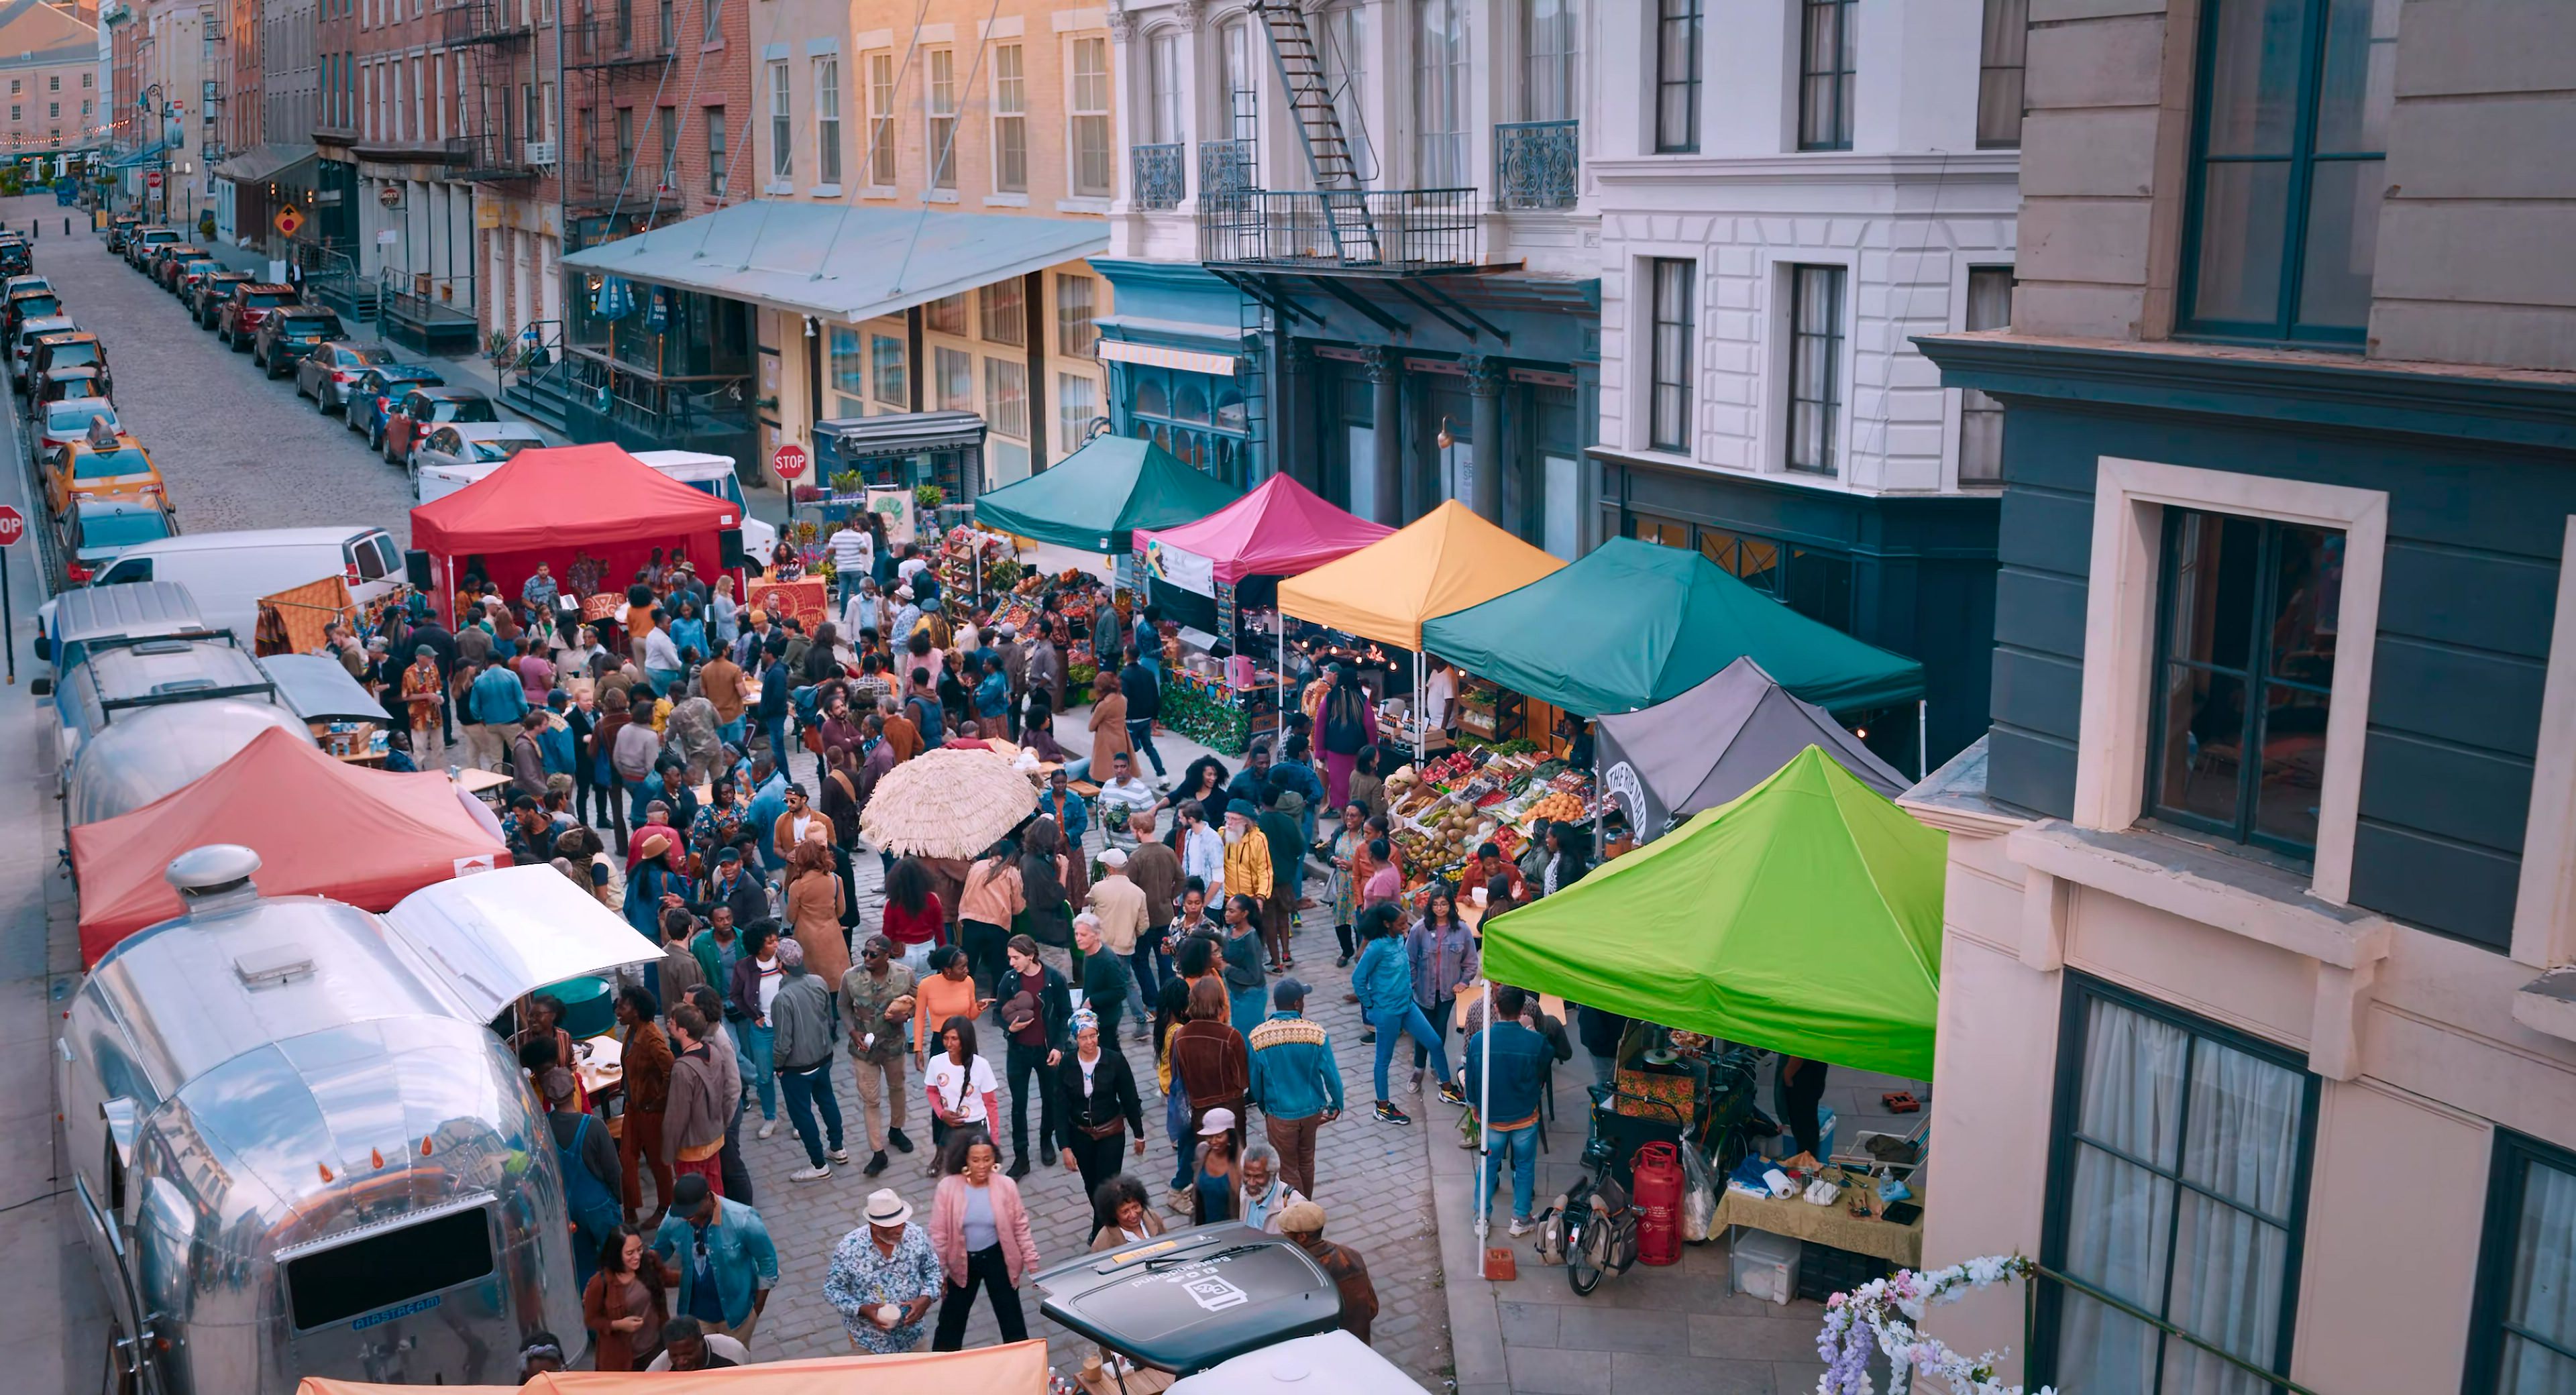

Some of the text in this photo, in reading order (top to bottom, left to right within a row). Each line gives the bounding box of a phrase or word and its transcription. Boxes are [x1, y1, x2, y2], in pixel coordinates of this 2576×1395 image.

[148, 176, 162, 184] STOP
[775, 455, 805, 469] STOP
[0, 518, 21, 534] OP
[1609, 766, 1644, 833] THE RIB MAN
[1132, 1256, 1232, 1288] BeatsandGrind
[356, 1296, 439, 1329] AIRSTREAM
